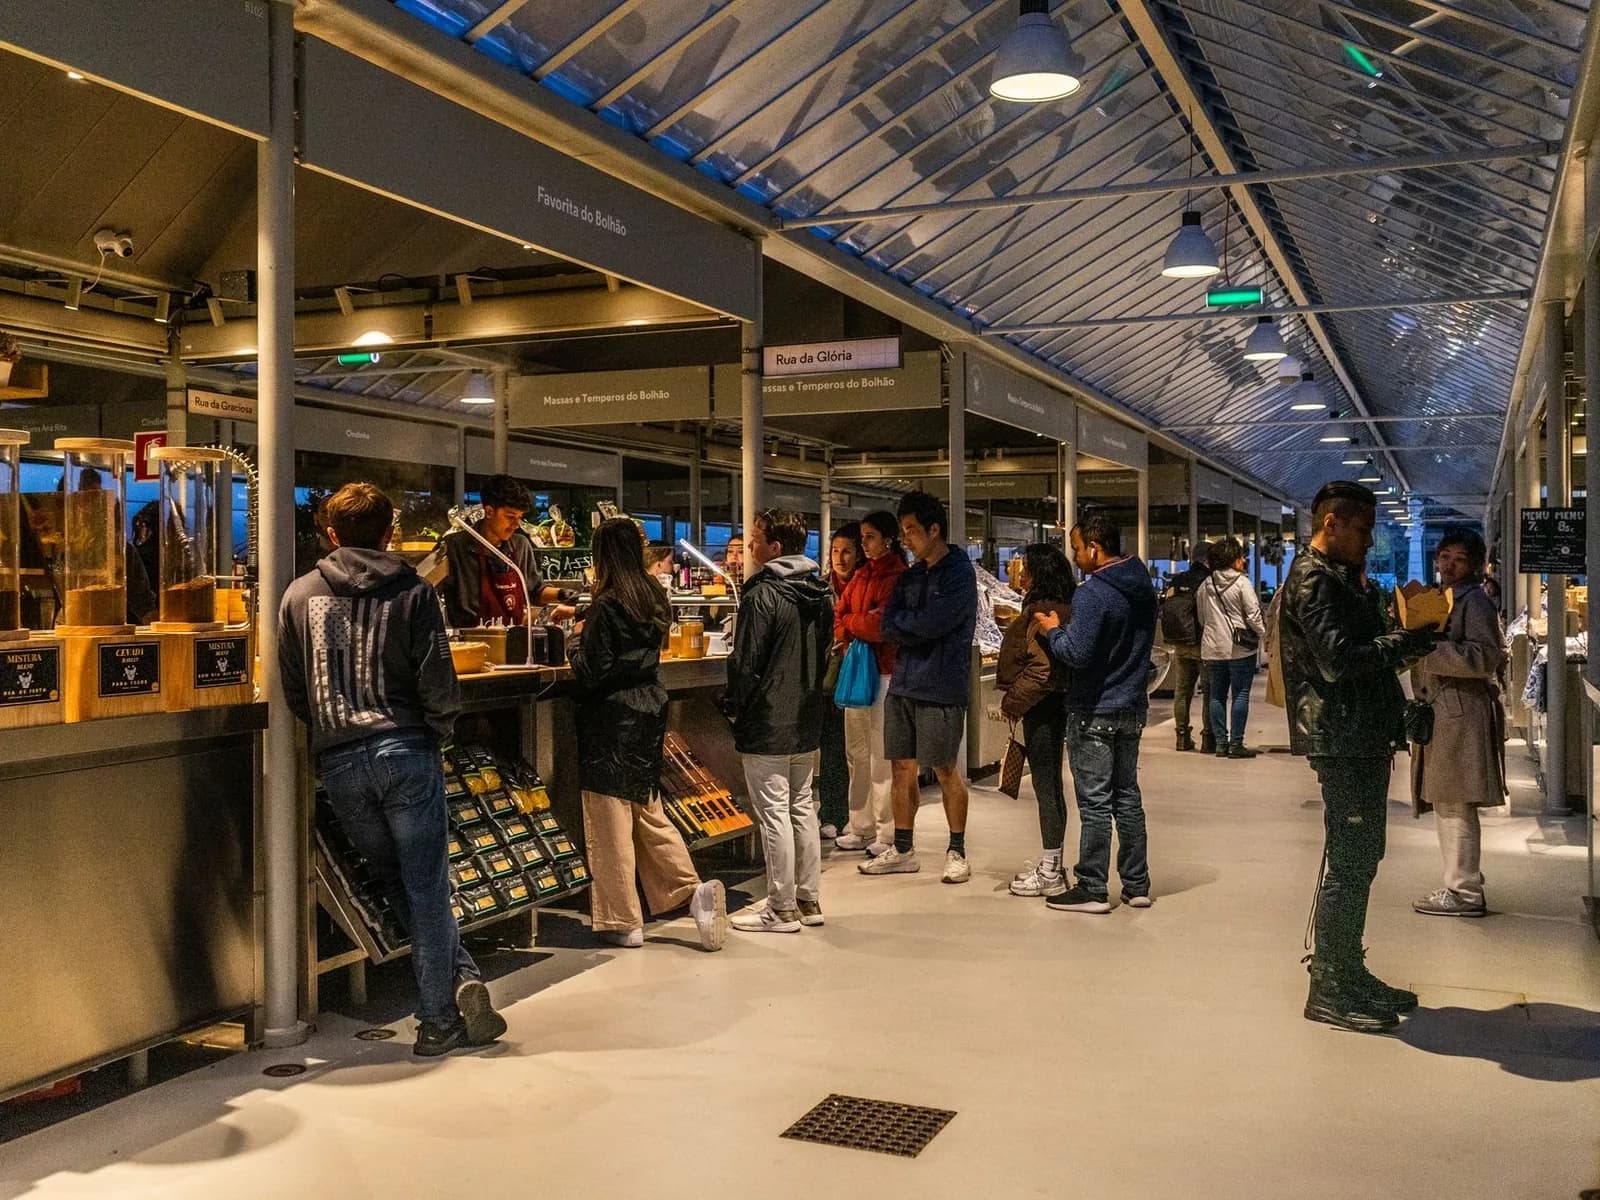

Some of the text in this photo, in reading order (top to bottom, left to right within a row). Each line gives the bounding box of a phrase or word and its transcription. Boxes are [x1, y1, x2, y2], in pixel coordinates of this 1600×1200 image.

[537, 185, 626, 236] Favorita do Bolhão
[776, 350, 852, 365] Rua da Glória
[762, 376, 895, 393] assas e Temperos do Bolhão
[194, 396, 253, 414] Rua da Graciosa
[543, 396, 574, 405] Massas
[582, 393, 625, 404] Temperos
[626, 391, 638, 401] do
[639, 390, 670, 401] Bolhão
[1522, 511, 1585, 520] MENU MENU
[115, 648, 144, 656] CEVADA
[208, 641, 235, 650] MISTURA
[7, 653, 42, 664] MISTURA
